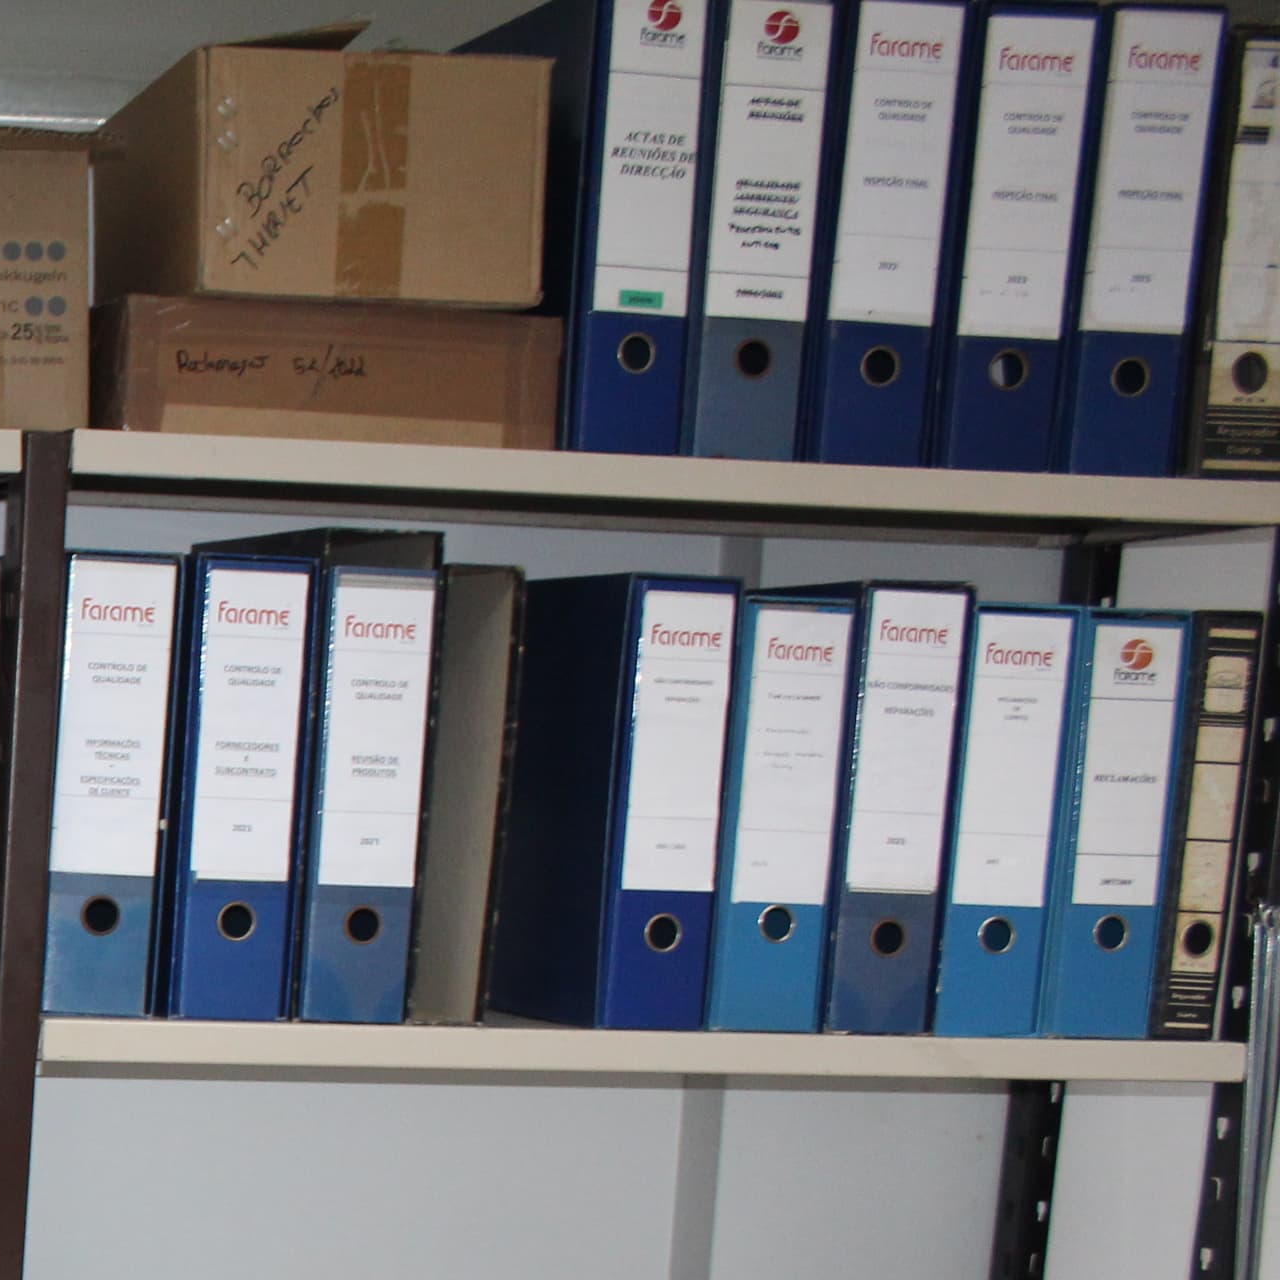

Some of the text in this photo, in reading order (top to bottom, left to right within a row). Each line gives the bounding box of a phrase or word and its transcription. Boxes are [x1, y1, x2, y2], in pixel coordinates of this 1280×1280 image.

[623, 131, 686, 146] ACTAS DE
[611, 145, 695, 164] REUNIÕES DE
[620, 163, 686, 179] DIRECÇÃO
[11, 323, 33, 340] 25
